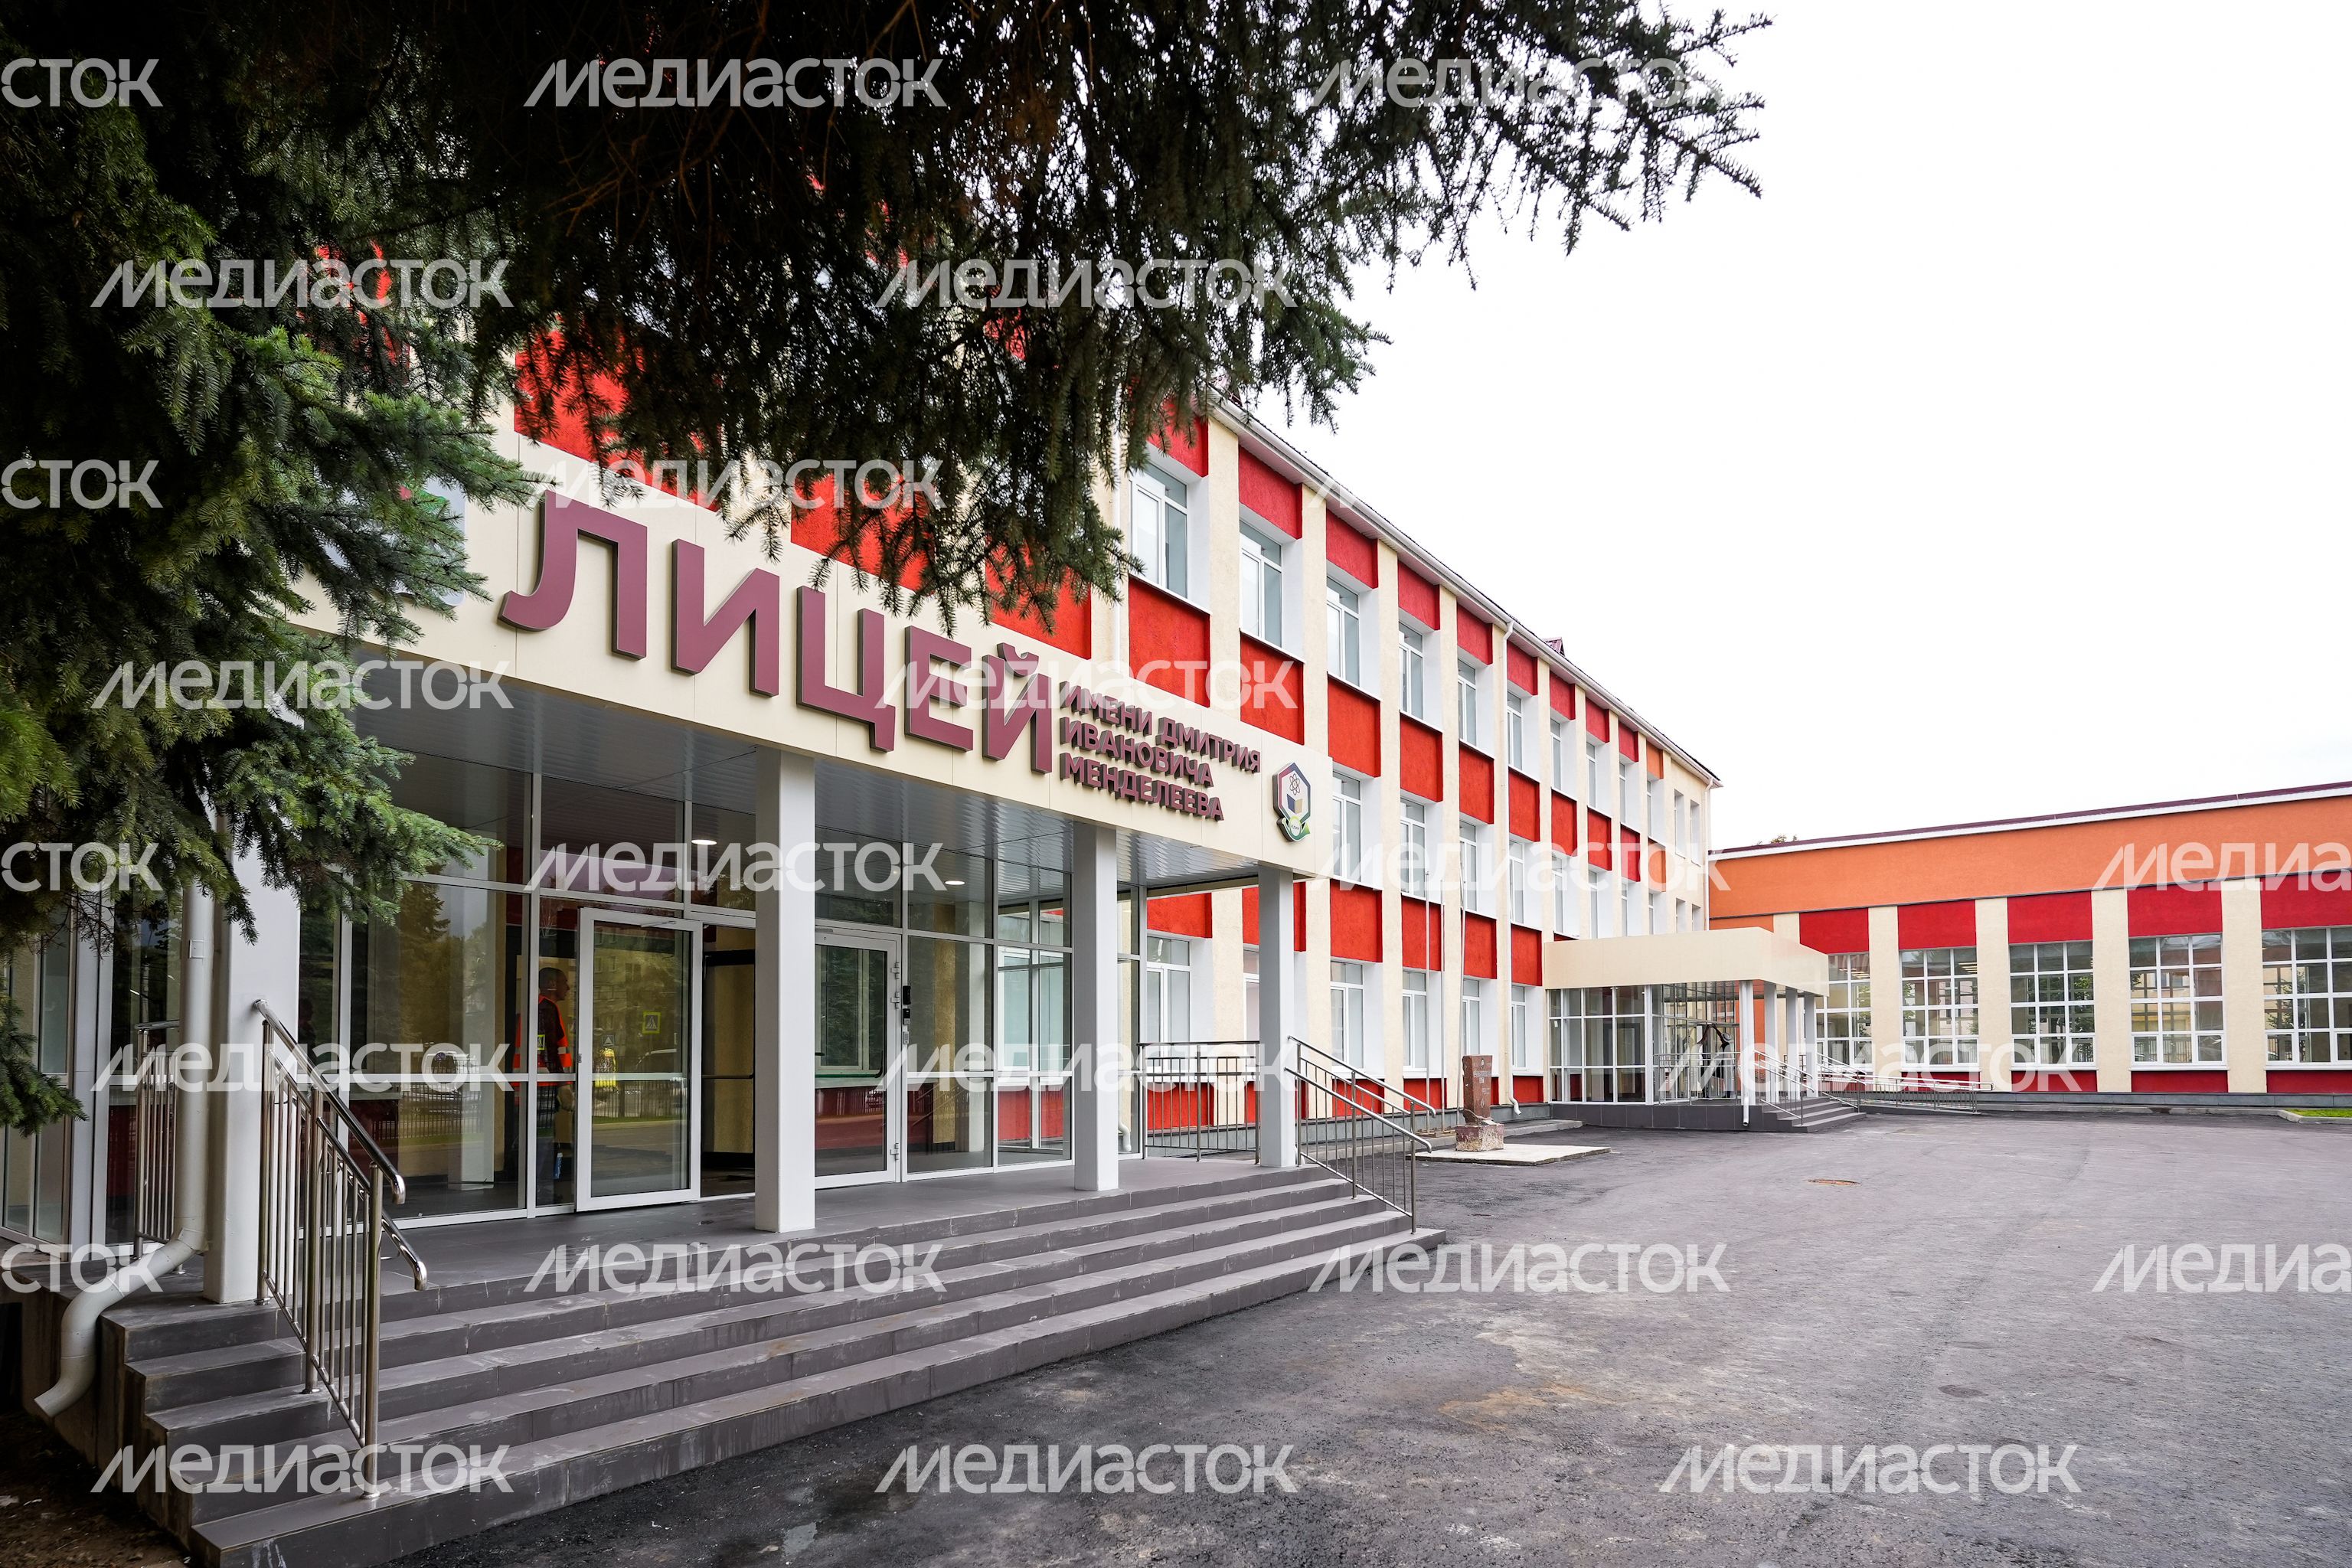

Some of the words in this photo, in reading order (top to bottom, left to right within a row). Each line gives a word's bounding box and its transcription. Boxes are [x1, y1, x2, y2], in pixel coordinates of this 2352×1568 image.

[498, 490, 1052, 774] ЛИЦЕЙ
[1060, 681, 1152, 736] ИМЕНИ
[1155, 717, 1261, 773] ДМИТРИЯ
[1060, 717, 1214, 787] ИВАНОВИЧА
[1060, 753, 1224, 822] МЕНДЕЛЕЕВА
